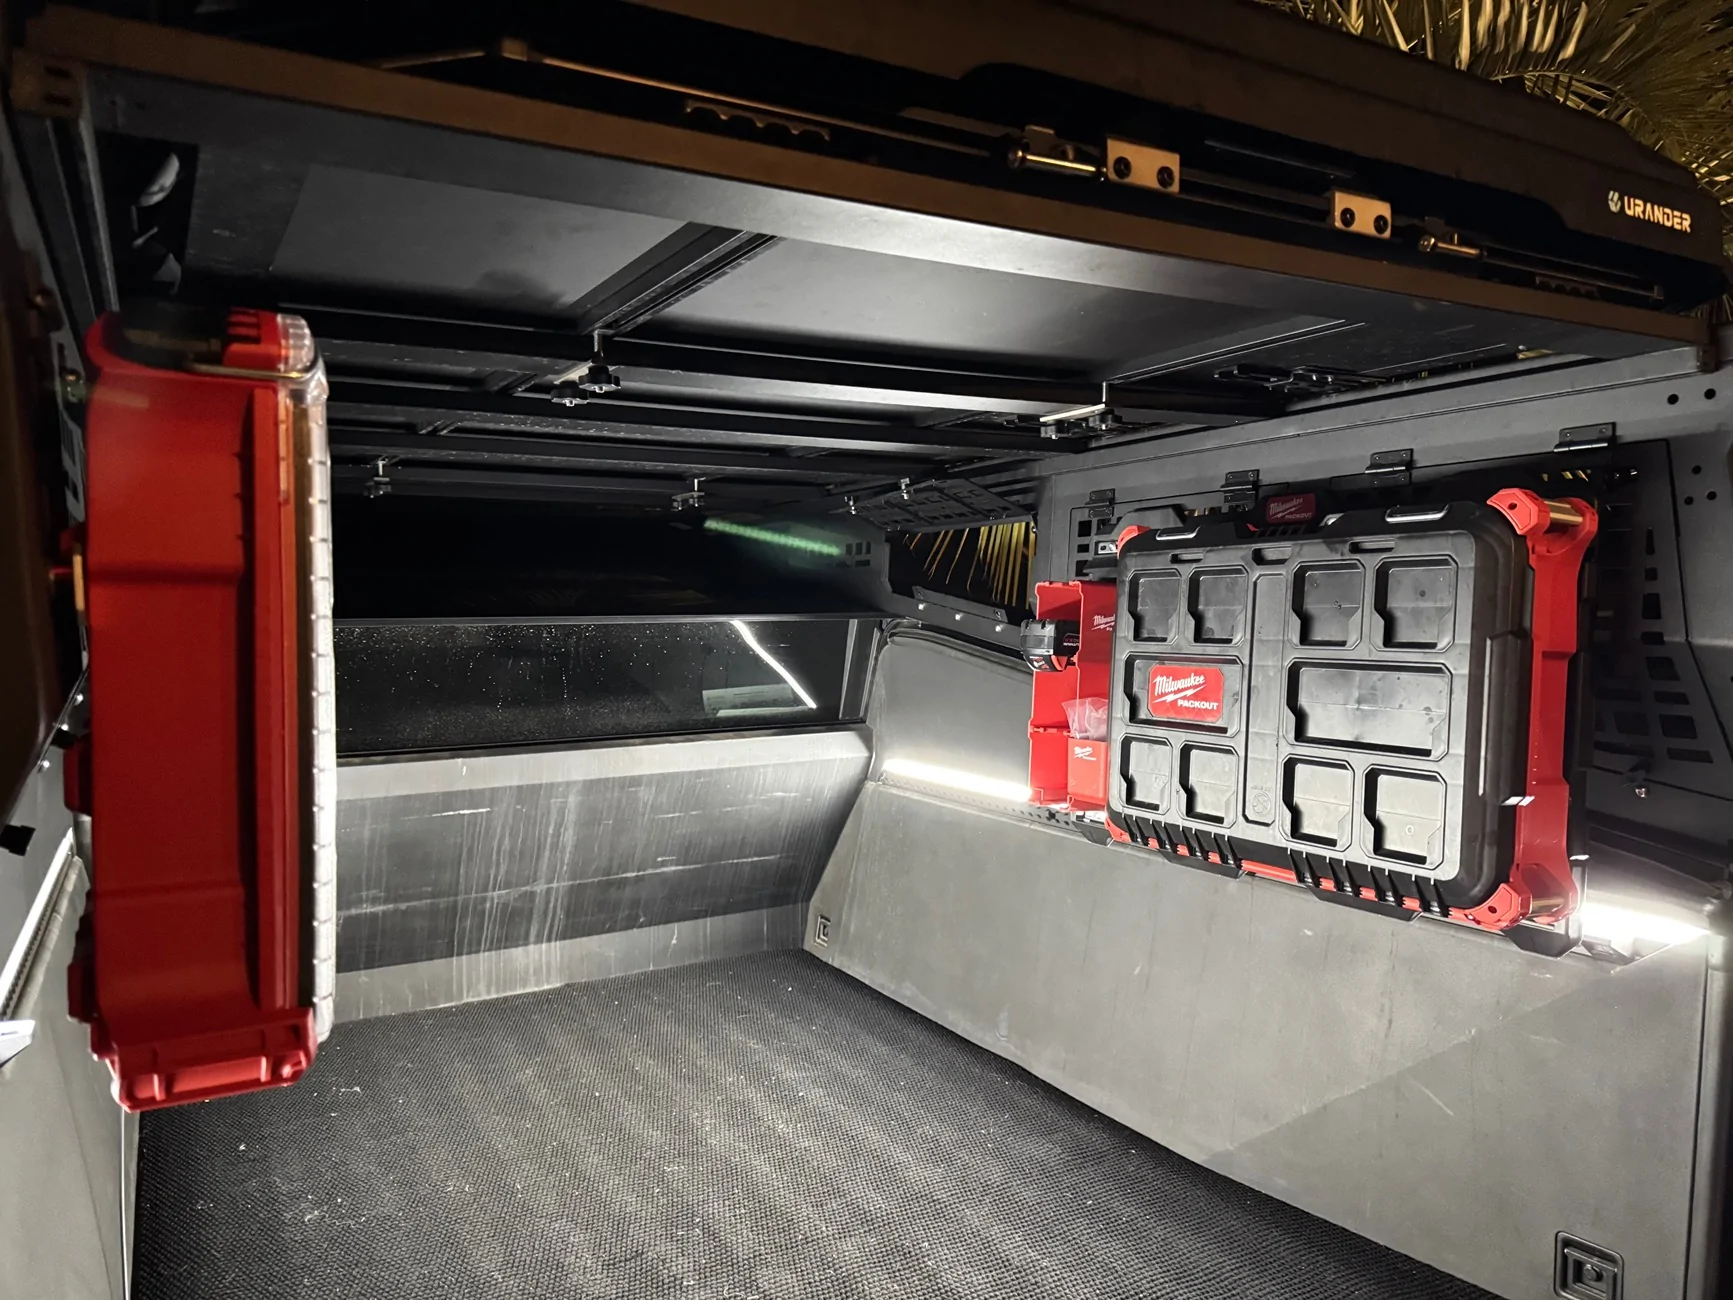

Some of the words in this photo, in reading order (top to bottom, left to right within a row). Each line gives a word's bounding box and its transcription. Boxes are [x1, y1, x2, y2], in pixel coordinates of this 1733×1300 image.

[1624, 195, 1691, 233] URANDER
[1152, 672, 1206, 697] Milwaukee
[1177, 699, 1219, 710] PACKOUT
